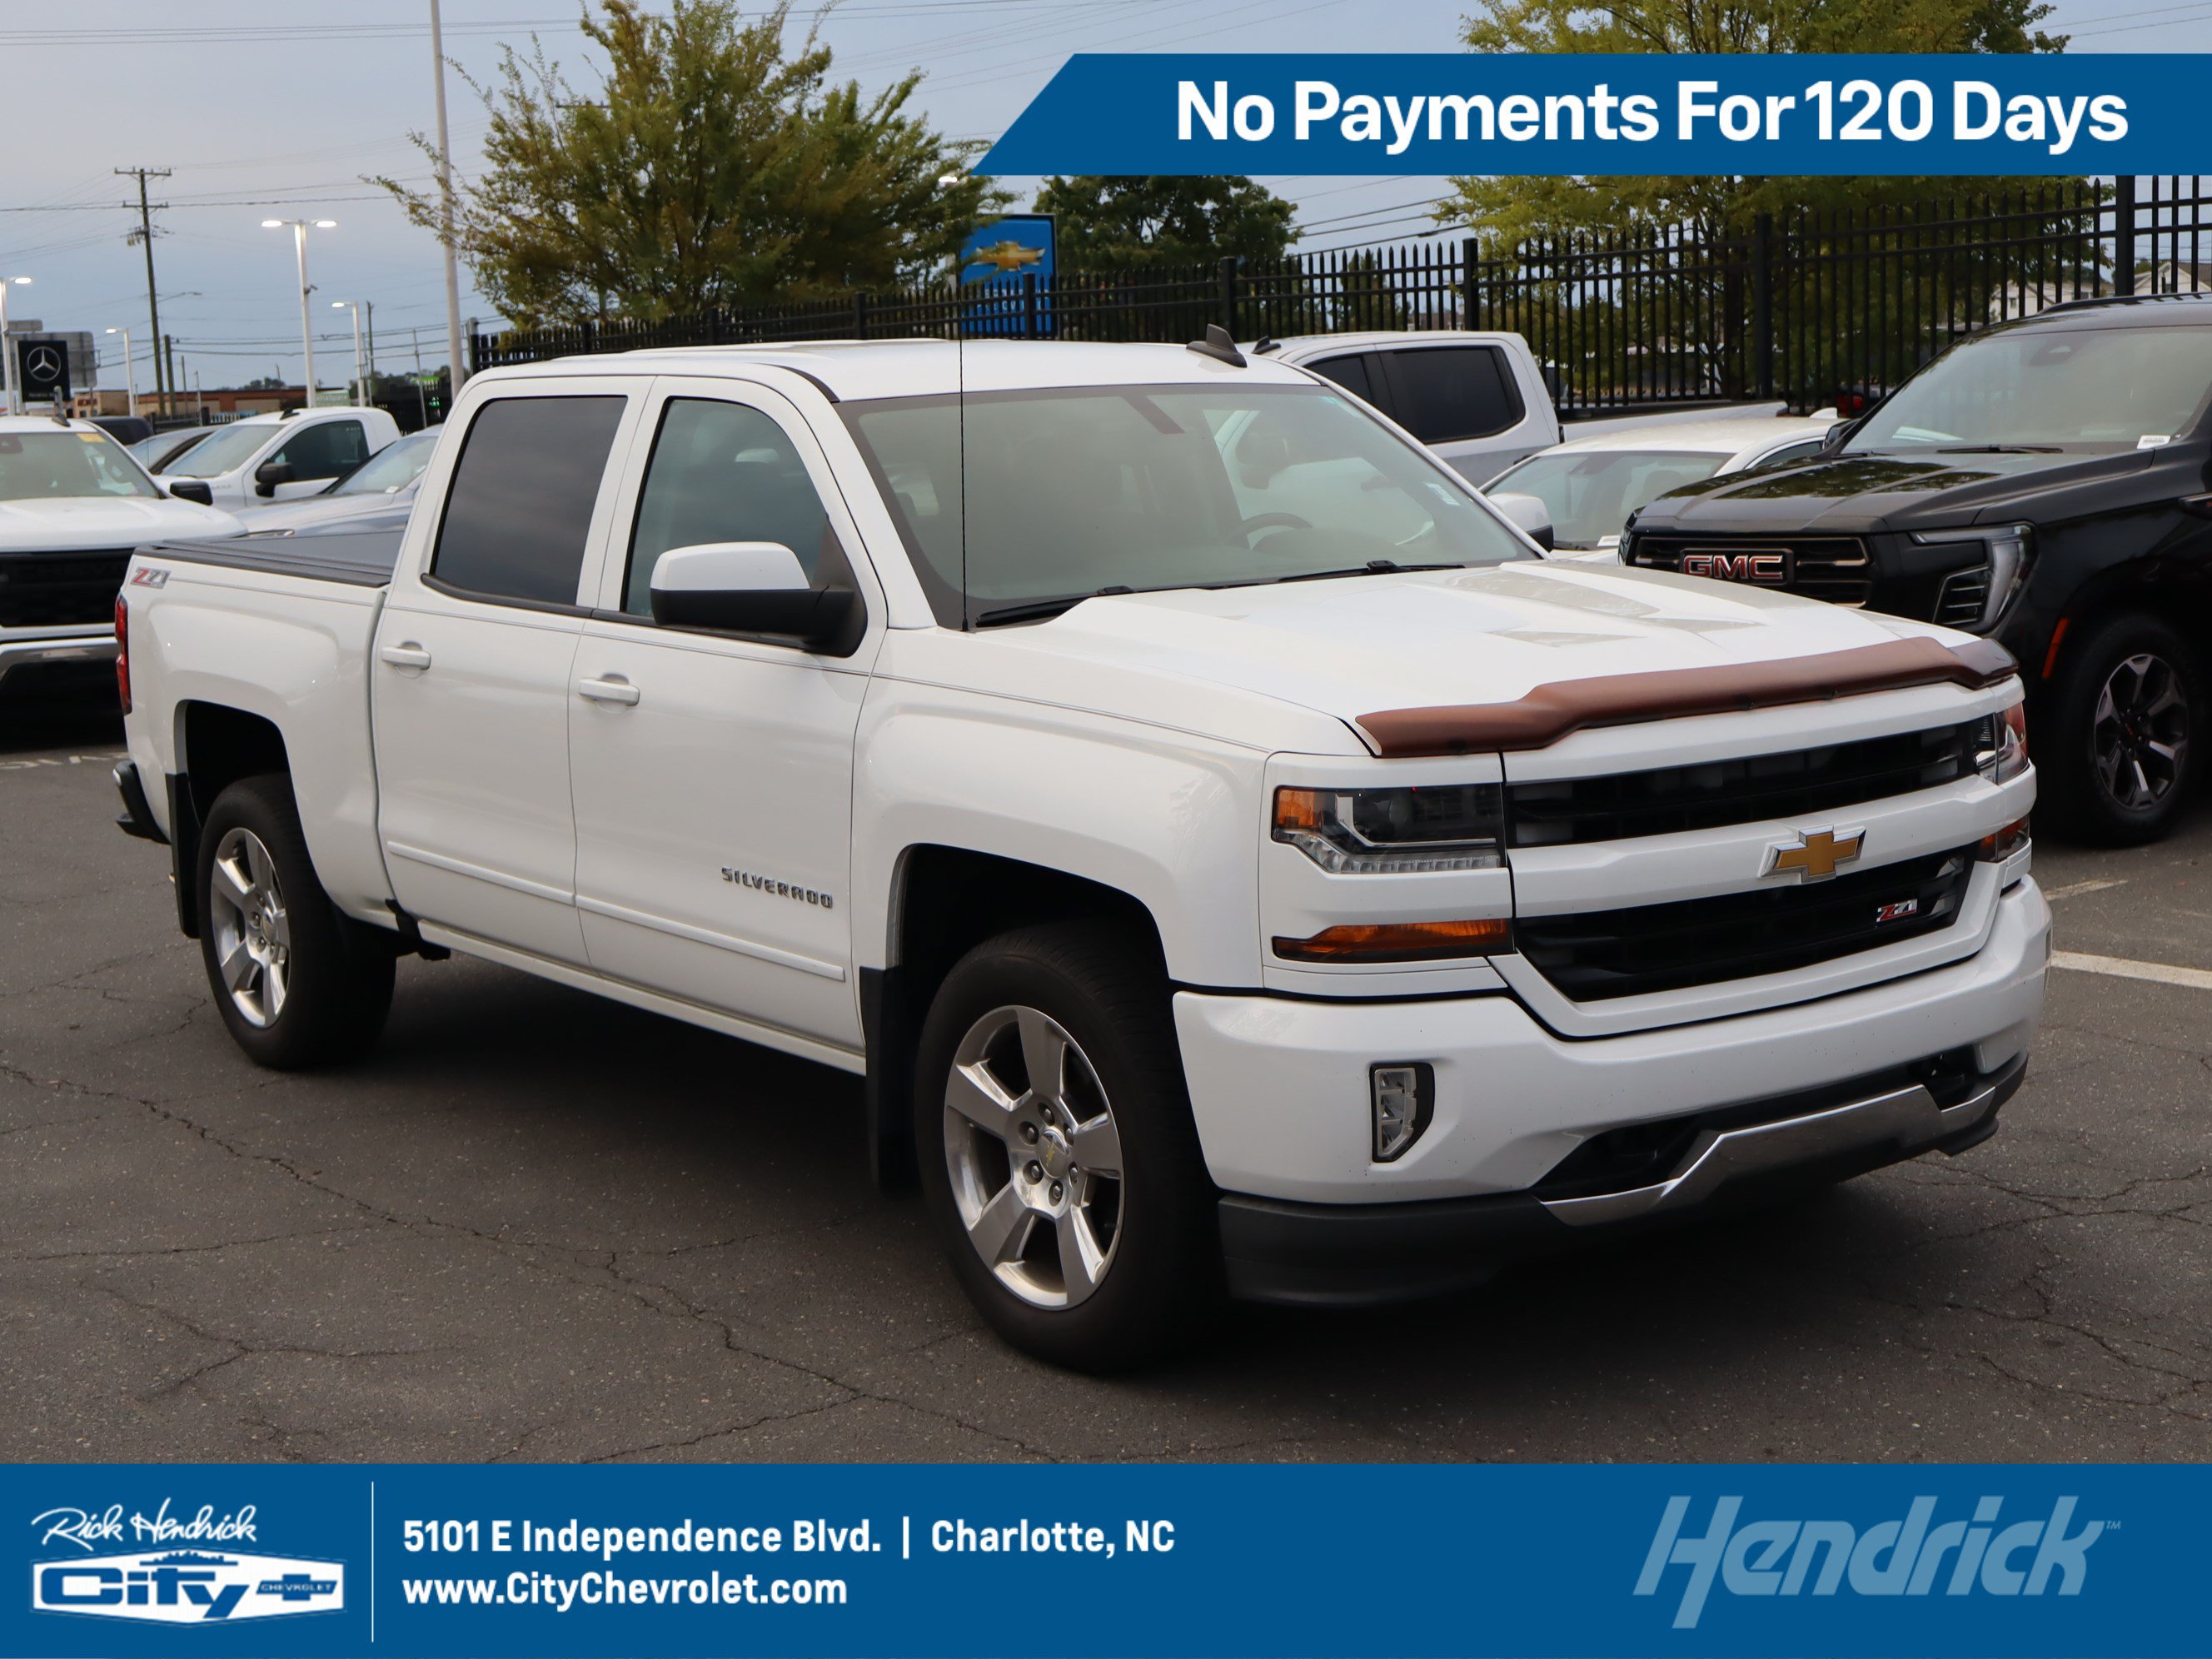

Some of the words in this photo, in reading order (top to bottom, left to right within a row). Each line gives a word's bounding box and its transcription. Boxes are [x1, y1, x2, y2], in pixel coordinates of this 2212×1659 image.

[130, 567, 172, 590] Z71
[1684, 555, 1783, 580] GMC
[721, 865, 834, 909] SILVERADO
[1876, 899, 1918, 924] Z71
